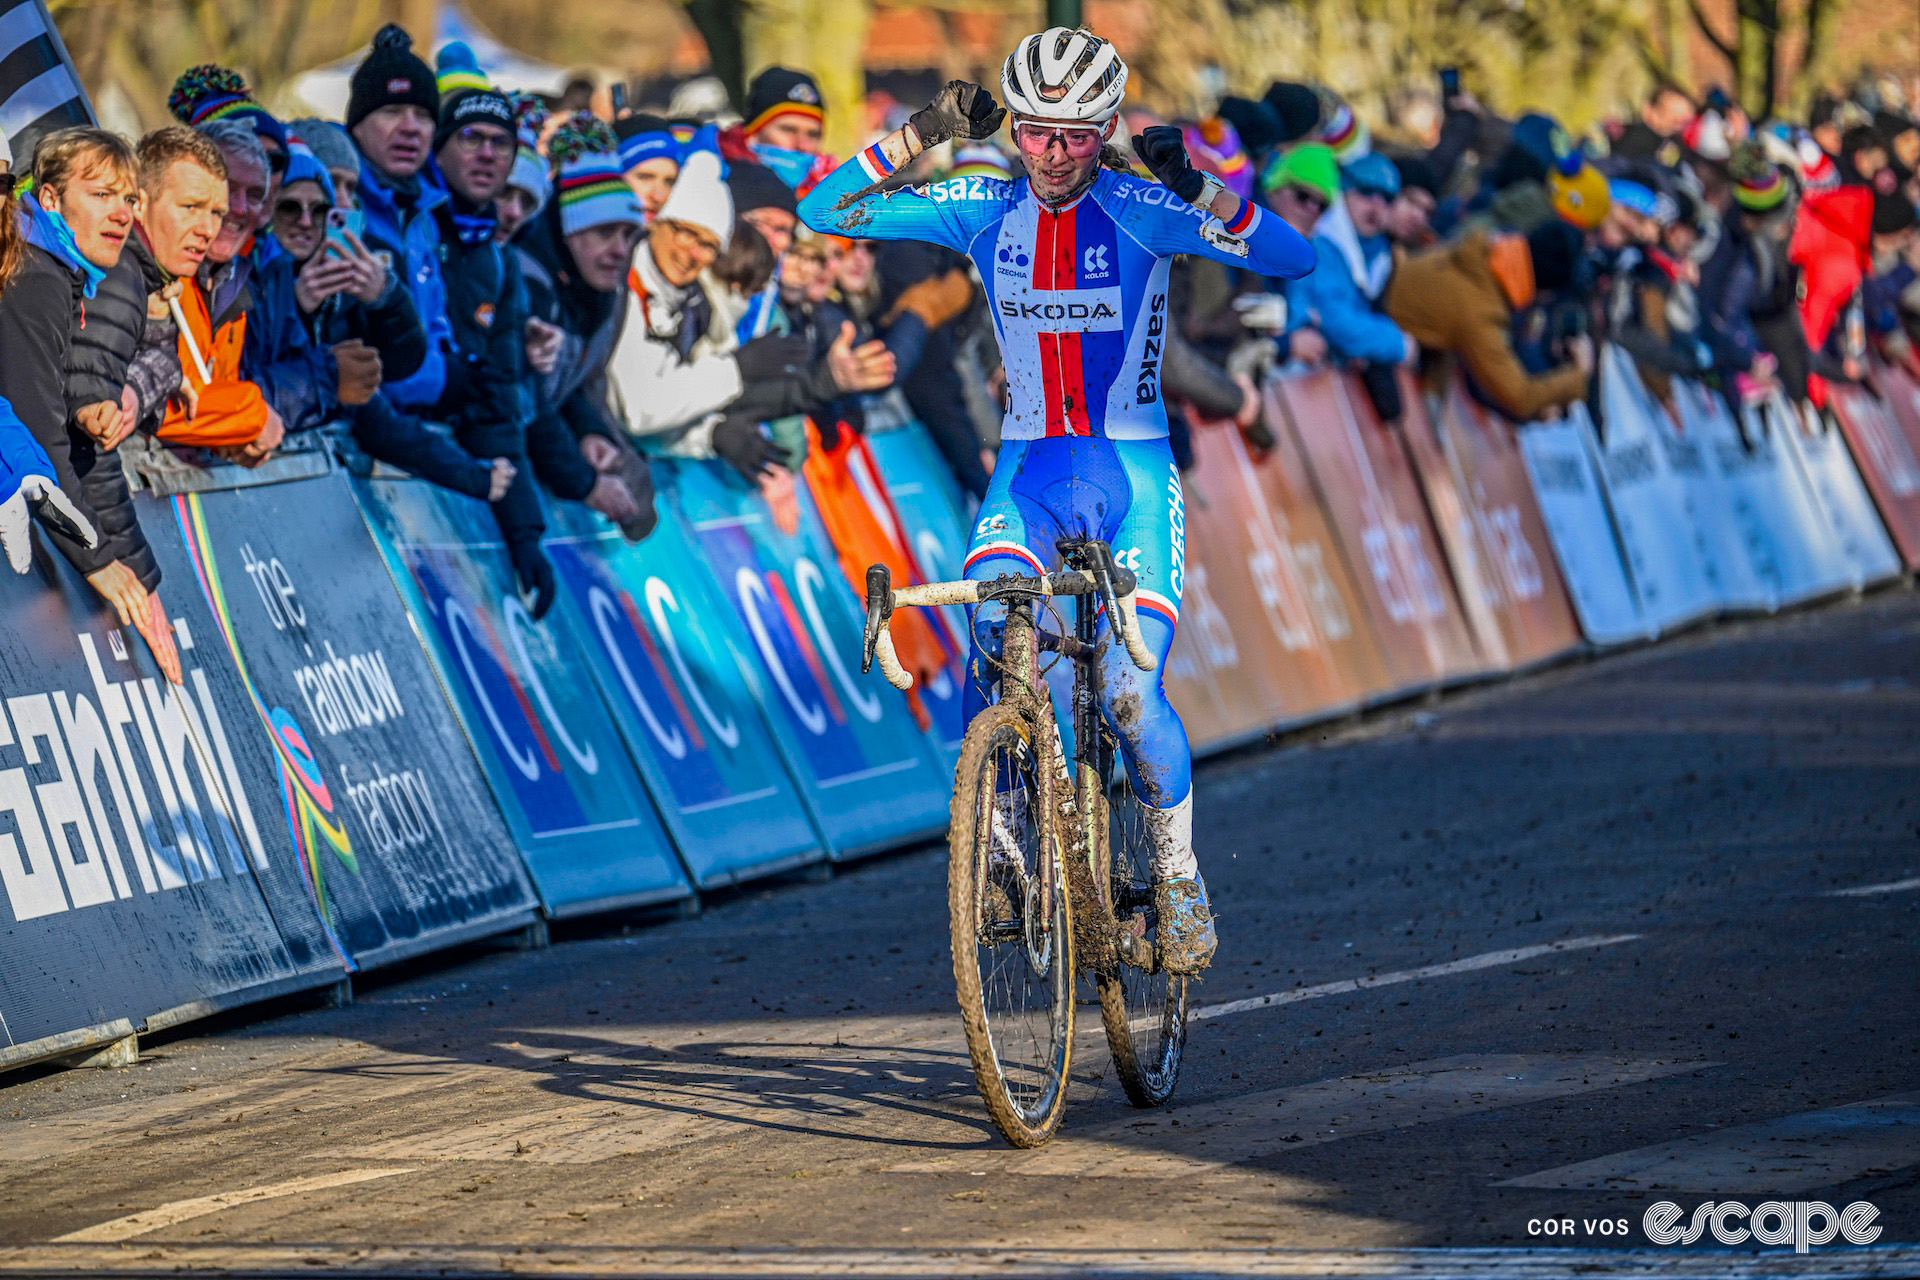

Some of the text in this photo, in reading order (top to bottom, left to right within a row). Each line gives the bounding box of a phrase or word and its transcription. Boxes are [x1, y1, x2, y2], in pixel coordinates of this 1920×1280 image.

[997, 266, 1027, 279] CZECHIA
[1136, 293, 1165, 405] sazka
[1168, 462, 1185, 600] CZECHIA
[239, 542, 306, 631] the
[293, 639, 404, 737] rainbow
[340, 762, 454, 862] factory
